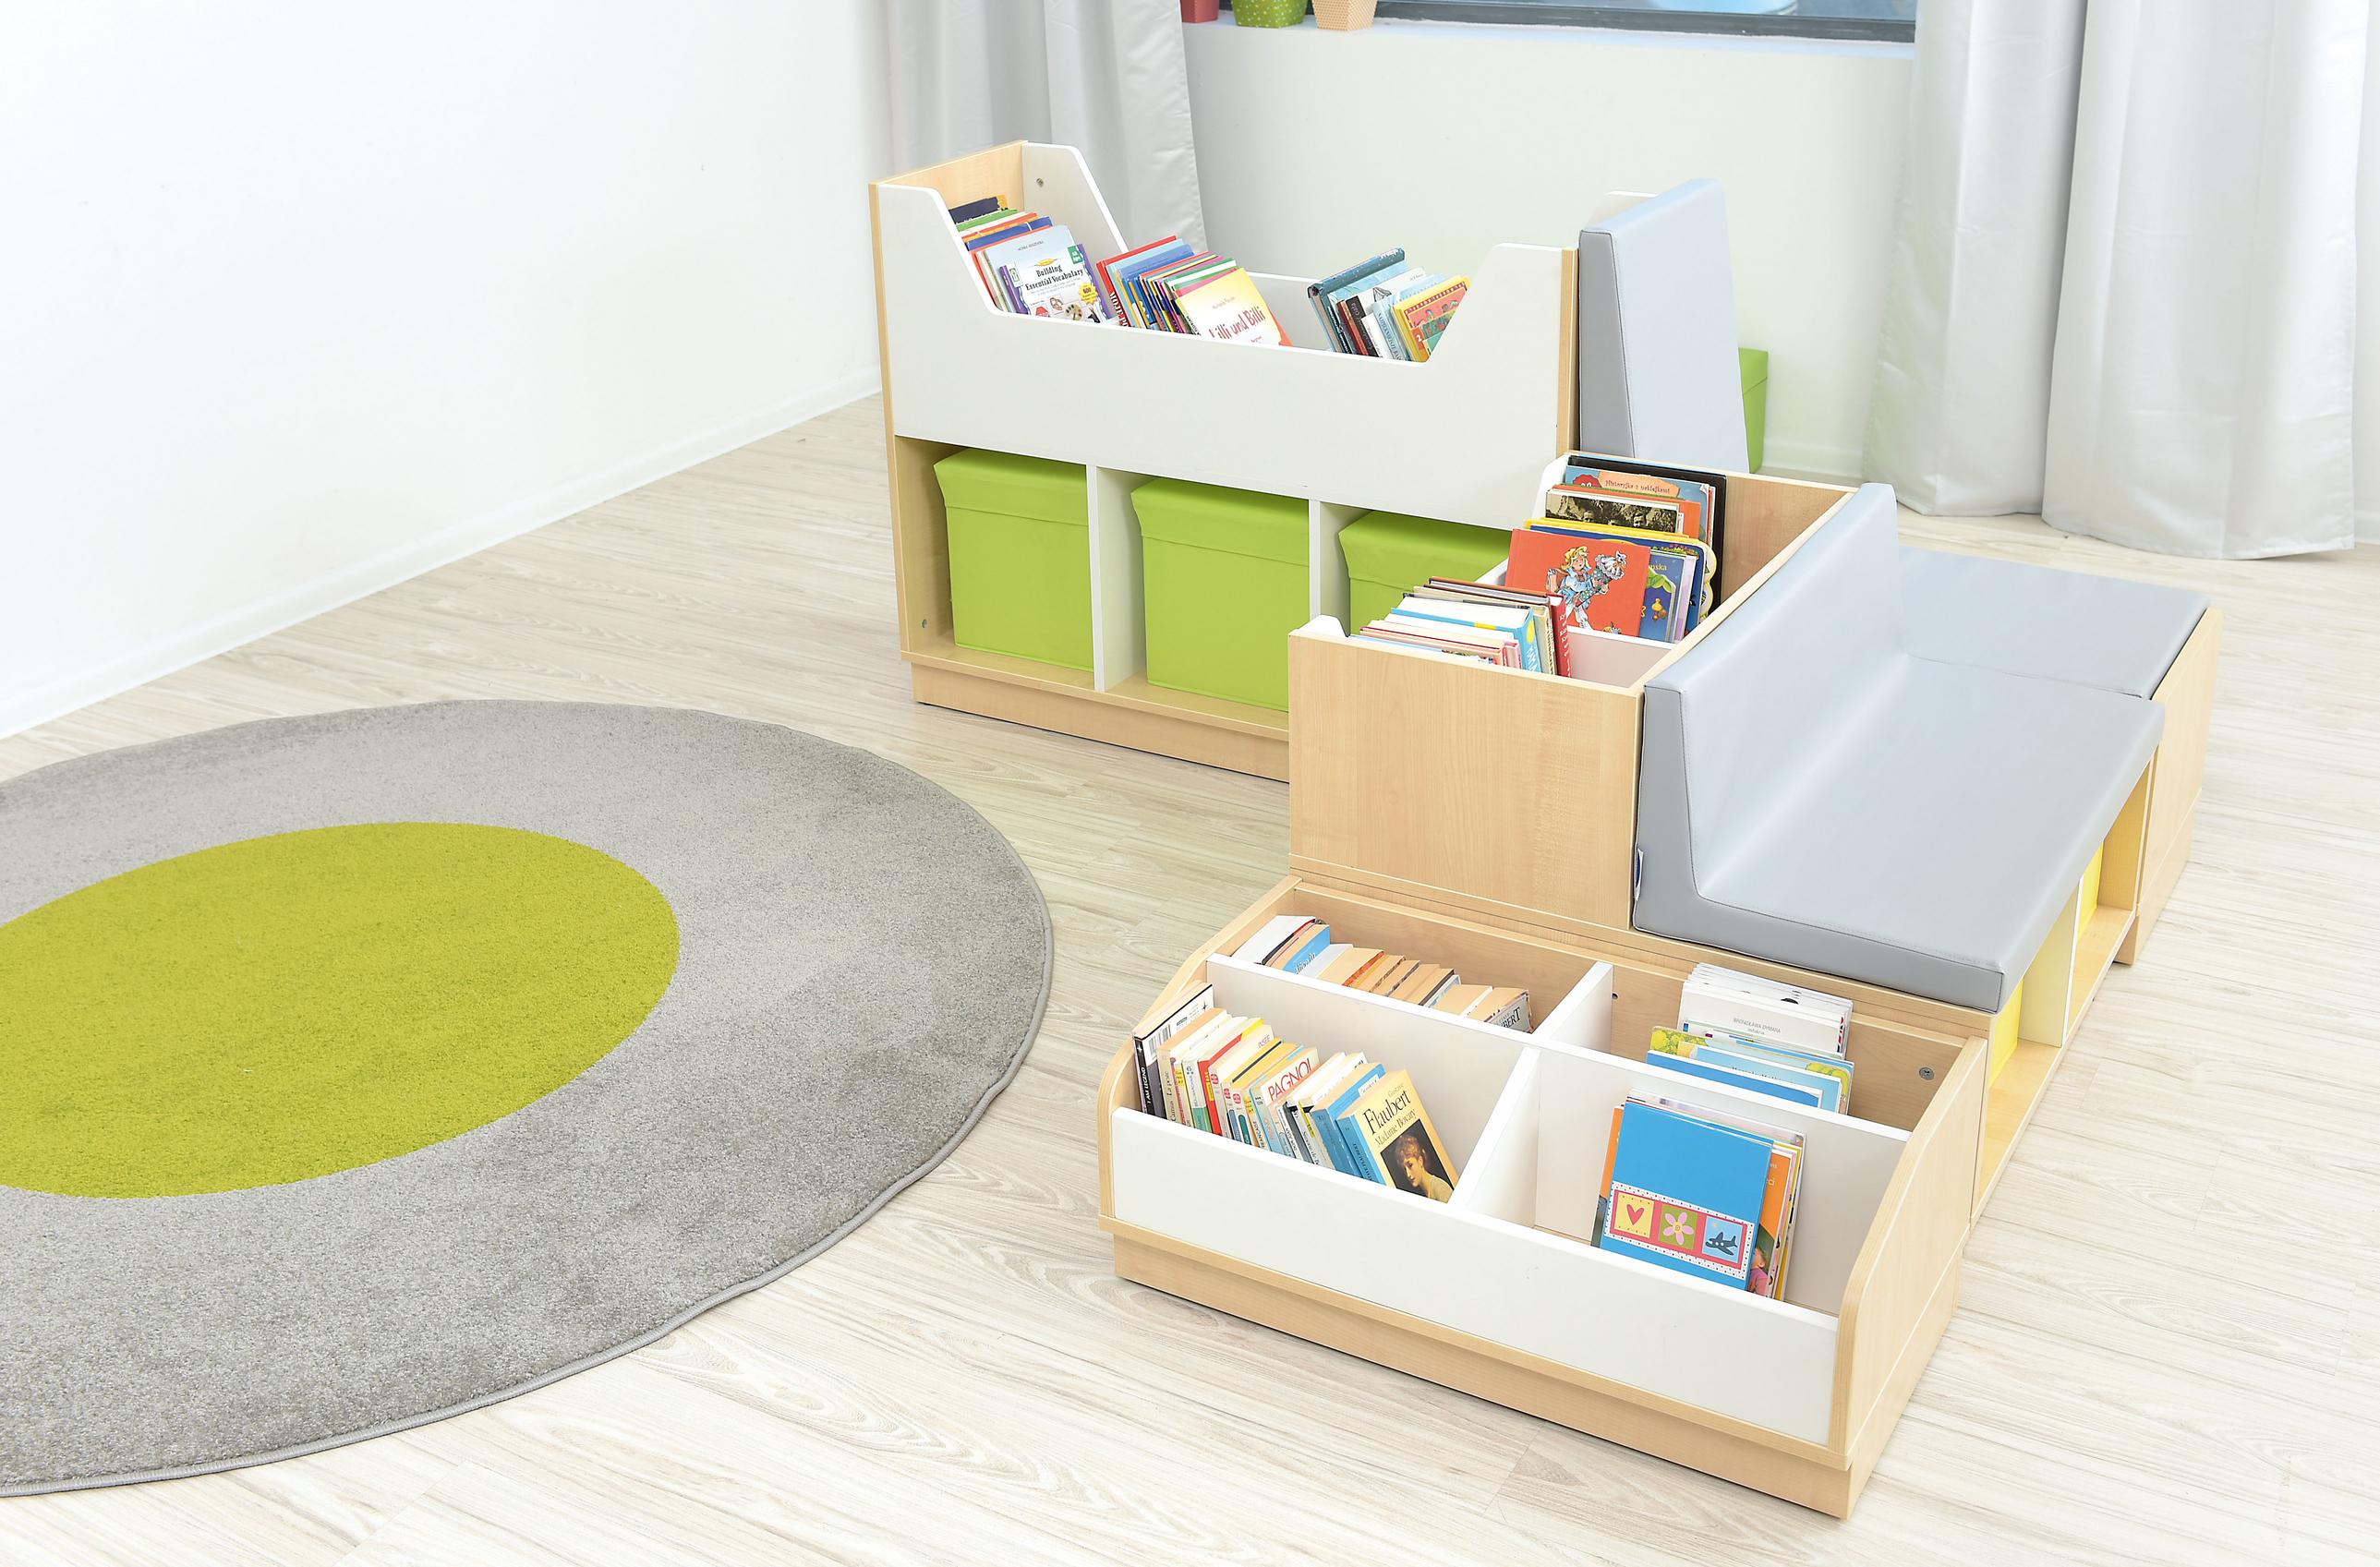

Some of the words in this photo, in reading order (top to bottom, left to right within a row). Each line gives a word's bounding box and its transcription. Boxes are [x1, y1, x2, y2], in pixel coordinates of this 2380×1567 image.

[1024, 277, 1052, 291] Essential
[1051, 268, 1083, 284] Vocabulary
[1035, 264, 1063, 278] Building
[1243, 306, 1266, 326] Billi
[1416, 334, 1422, 343] 2
[1141, 1067, 1149, 1089] LEGEND
[1362, 1090, 1411, 1136] Flaubert
[1374, 1125, 1398, 1146] Madame
[1395, 1109, 1417, 1128] Bovary
